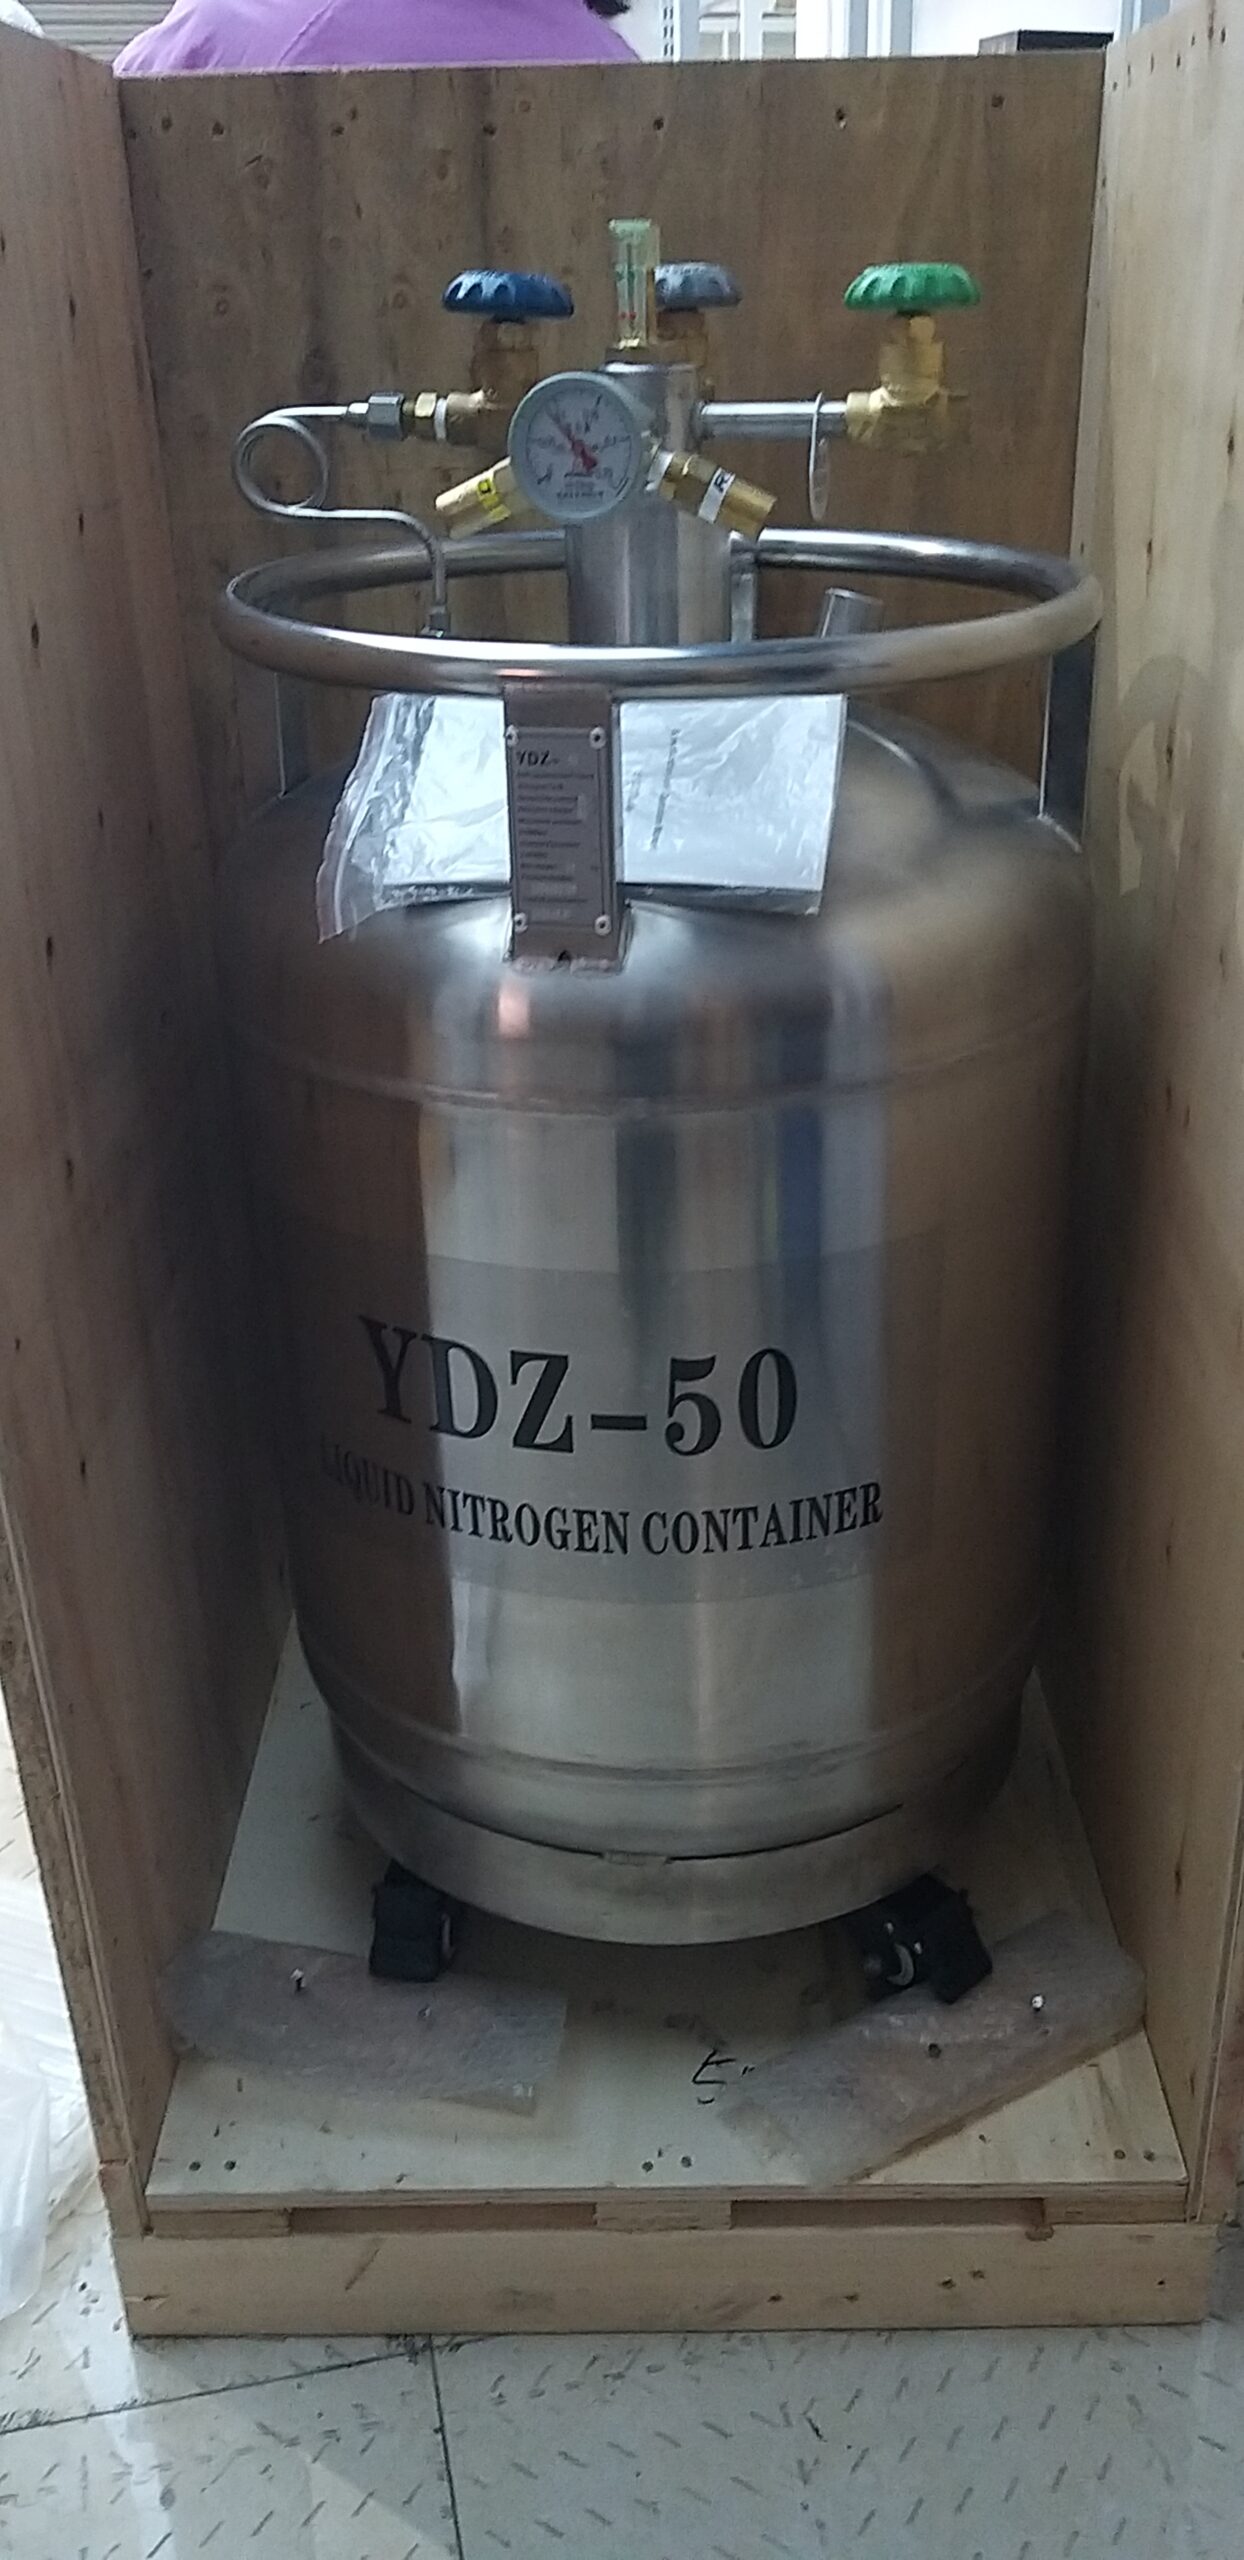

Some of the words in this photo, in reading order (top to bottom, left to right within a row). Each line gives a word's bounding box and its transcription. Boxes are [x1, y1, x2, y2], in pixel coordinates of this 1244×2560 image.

[357, 1315, 799, 1456] YDZ-50
[422, 1481, 629, 1556] NITROGEN
[641, 1482, 883, 1556] CONTAINER
